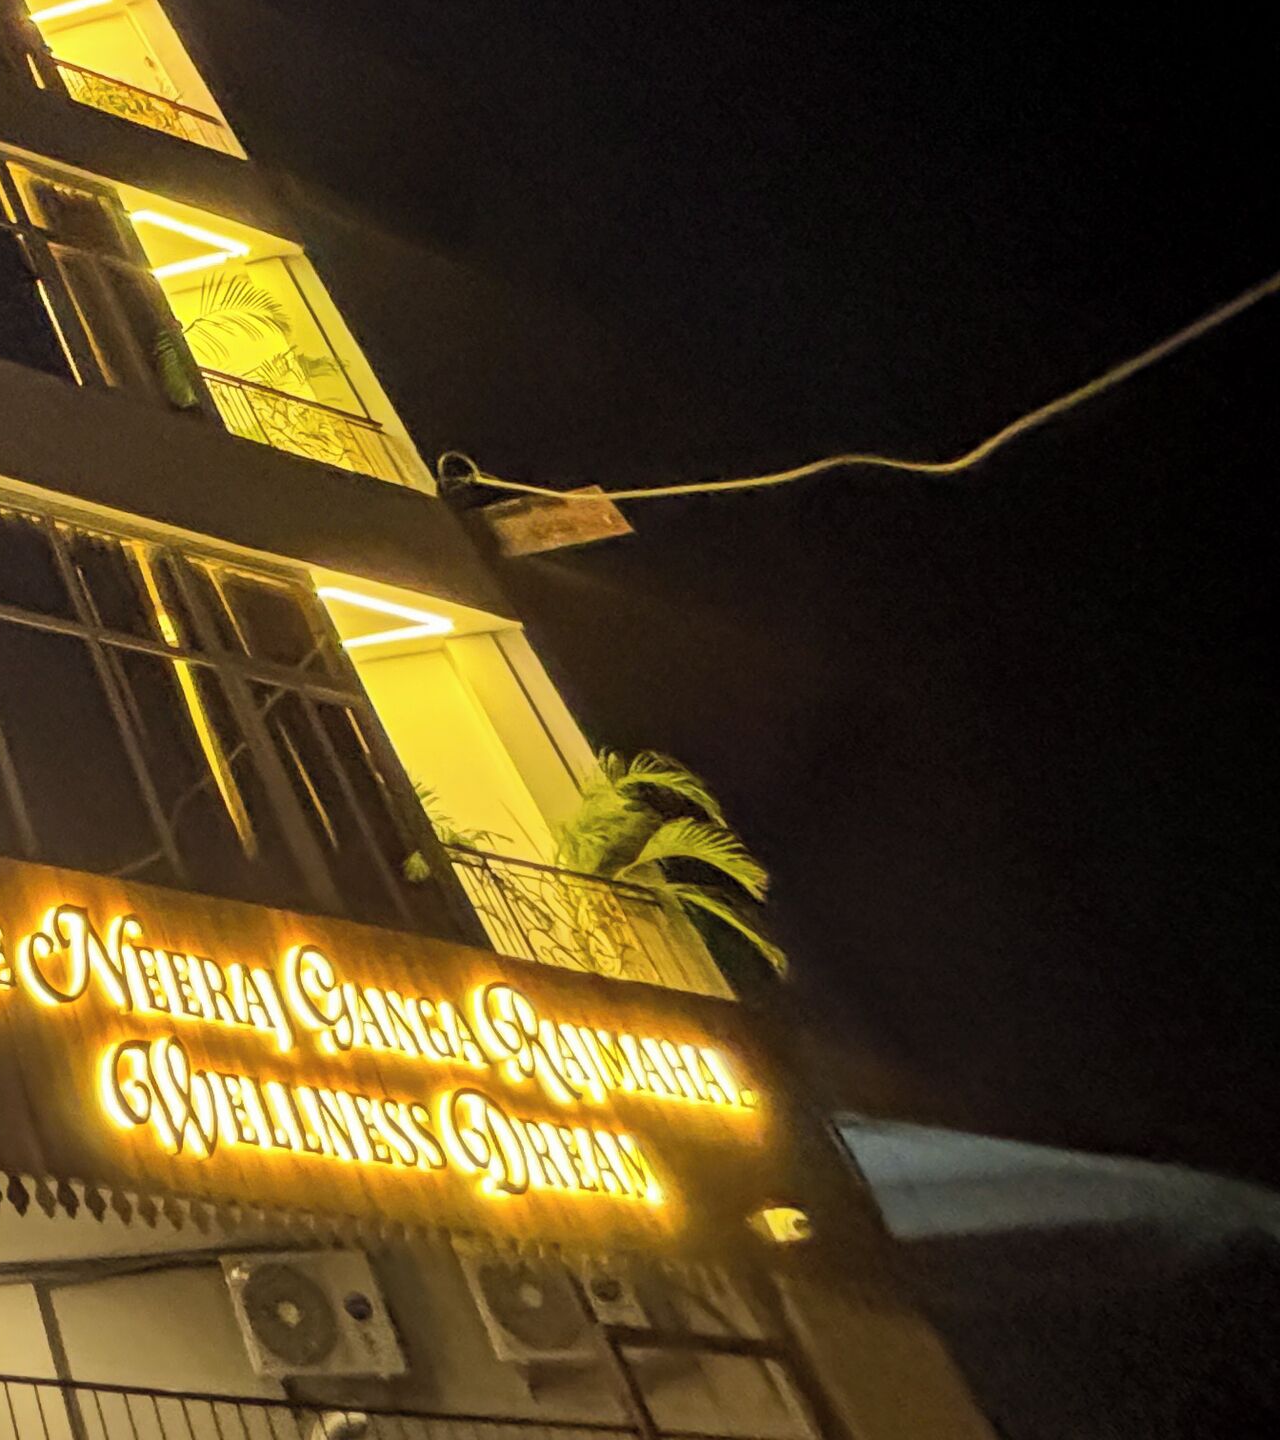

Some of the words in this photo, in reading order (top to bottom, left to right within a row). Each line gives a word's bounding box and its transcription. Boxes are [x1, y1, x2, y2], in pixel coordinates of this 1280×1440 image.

[18, 903, 295, 1053] NEERAJ
[286, 944, 491, 1067] GANGA
[100, 1036, 446, 1169] WELLNESS
[438, 1087, 663, 1203] DREAM
